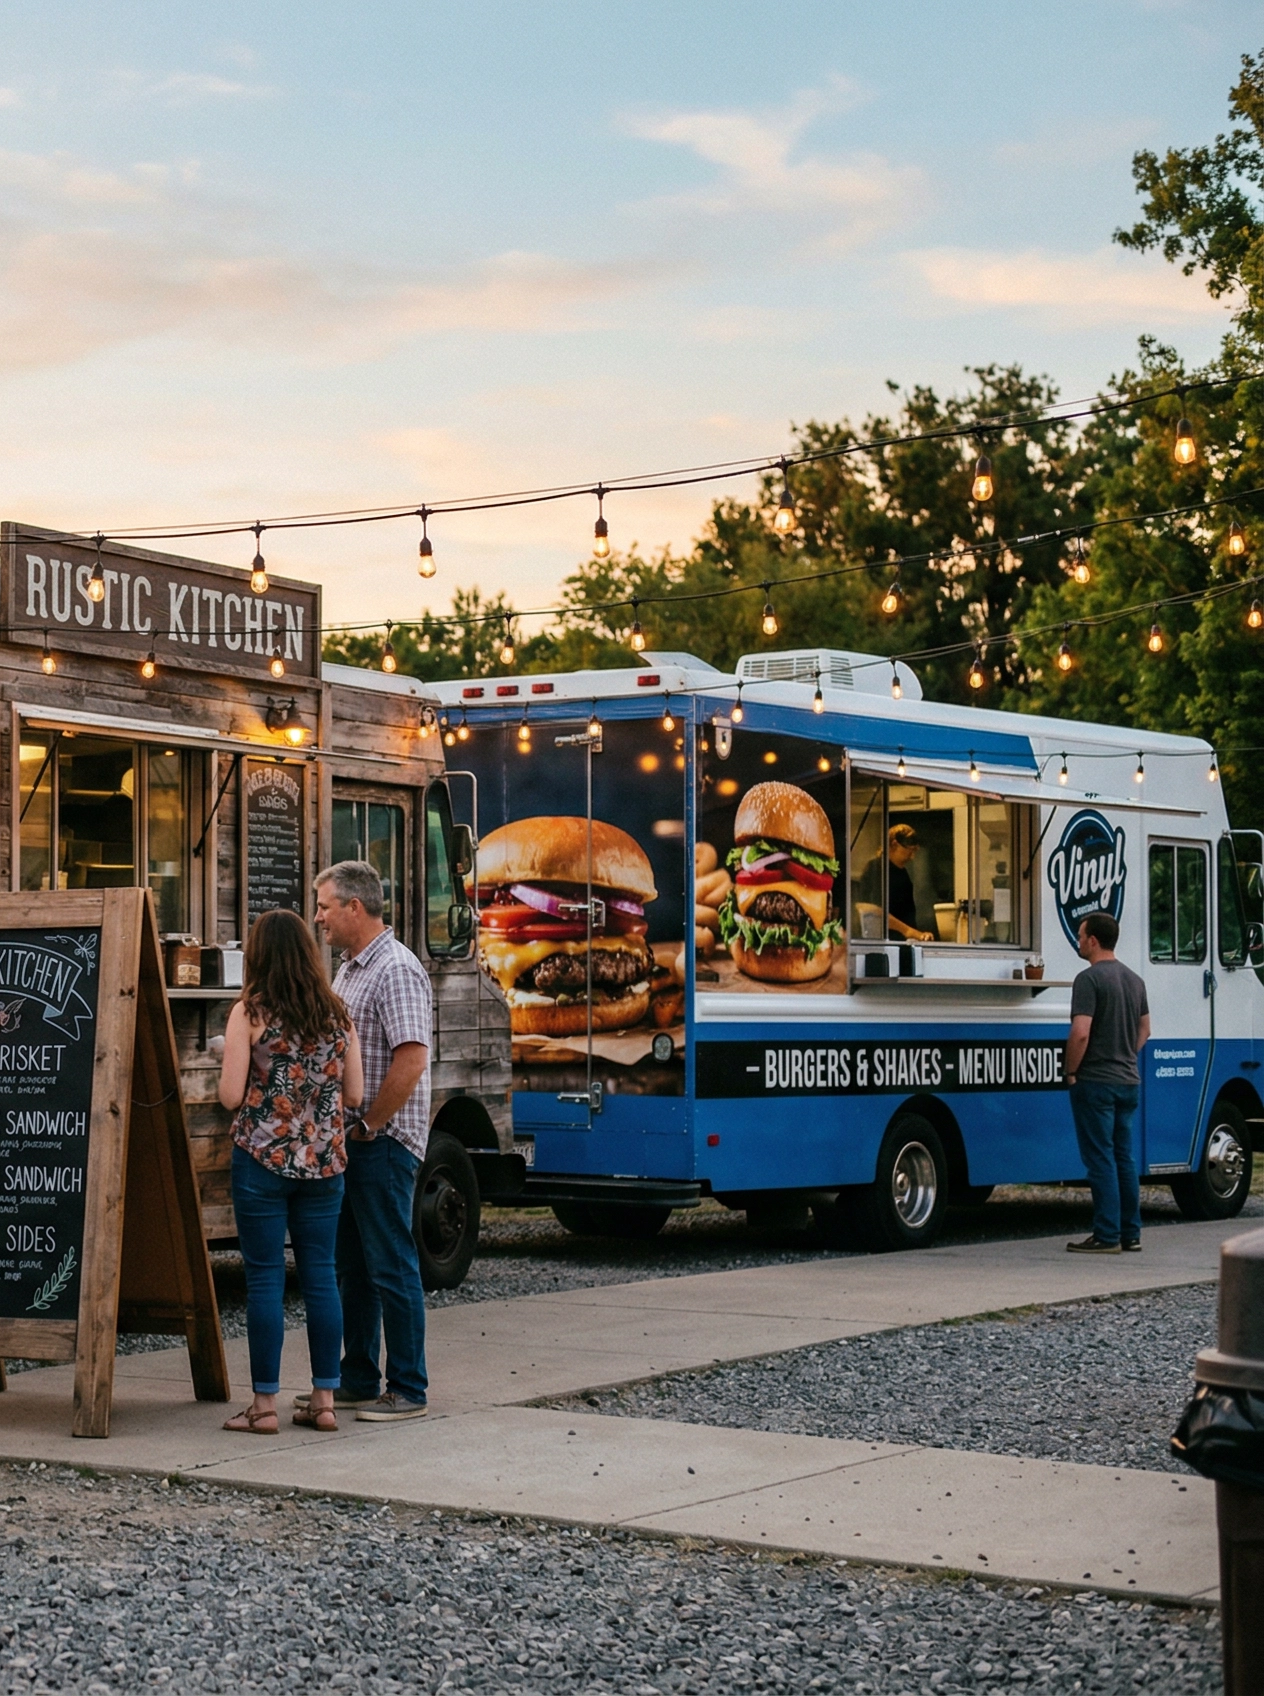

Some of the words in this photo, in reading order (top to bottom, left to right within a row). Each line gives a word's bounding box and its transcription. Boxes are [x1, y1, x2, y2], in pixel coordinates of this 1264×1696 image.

[25, 554, 152, 636] RUSTIC
[168, 581, 304, 661] KITCHEN
[1050, 832, 1125, 909] Vinyl
[765, 1049, 851, 1088] BURGERS
[856, 1049, 869, 1086] &
[873, 1048, 942, 1086] SHAKES
[959, 1047, 1006, 1085] MENU
[1011, 1047, 1063, 1084] INSIDE
[5, 1110, 86, 1136] SANDWICH
[4, 1165, 83, 1193] SANDWICH
[6, 1224, 56, 1253] SIDES
